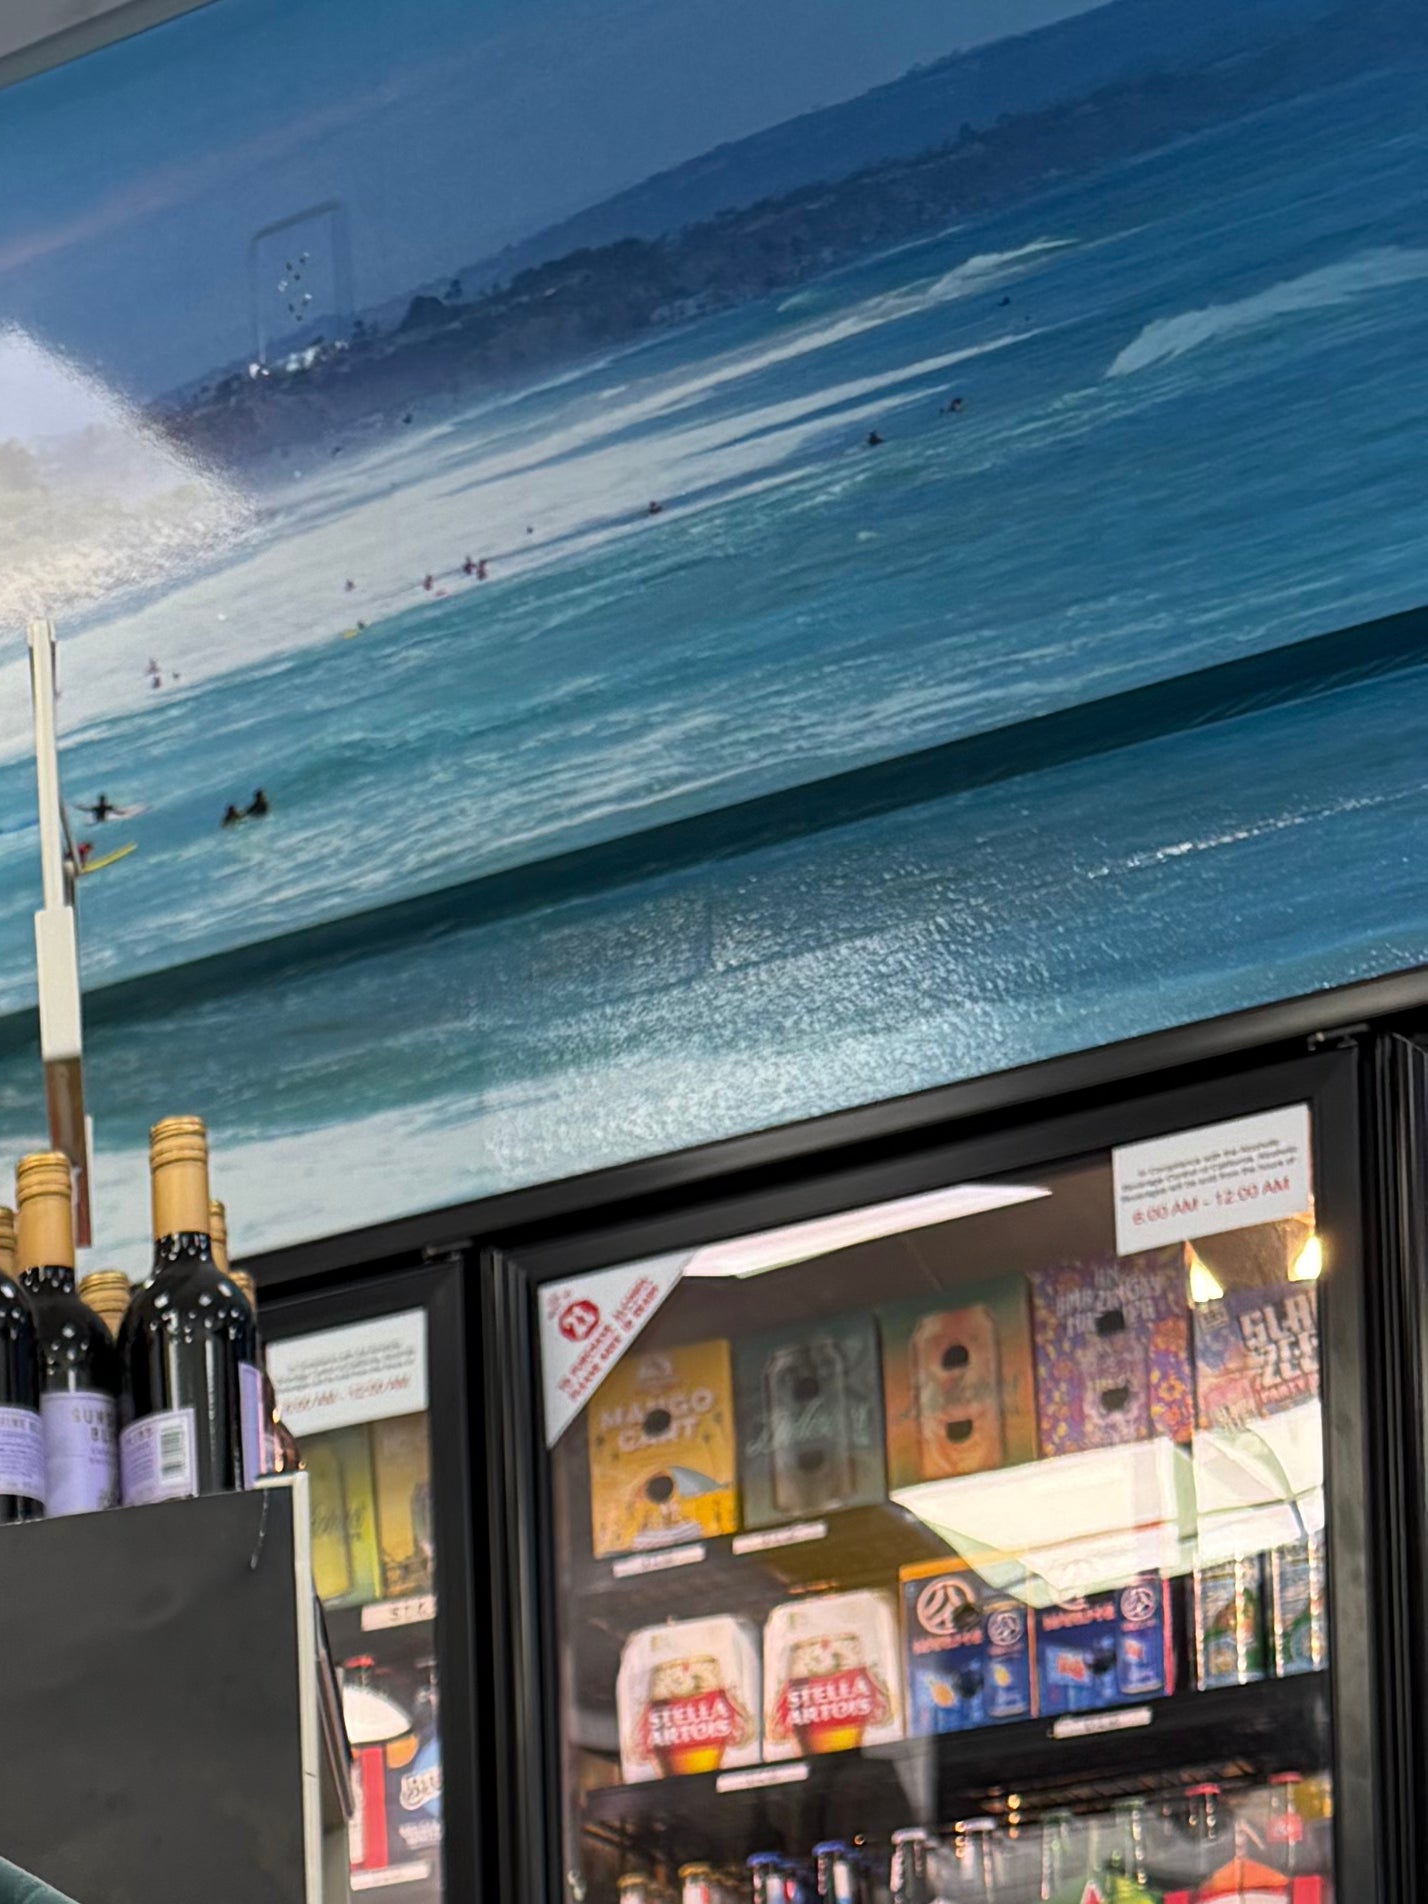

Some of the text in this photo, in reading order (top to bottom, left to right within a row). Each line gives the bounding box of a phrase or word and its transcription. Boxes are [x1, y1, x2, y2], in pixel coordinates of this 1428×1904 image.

[787, 1673, 872, 1706] STELLA
[647, 1695, 731, 1729] STELLA
[646, 1720, 732, 1750] ARTOIS
